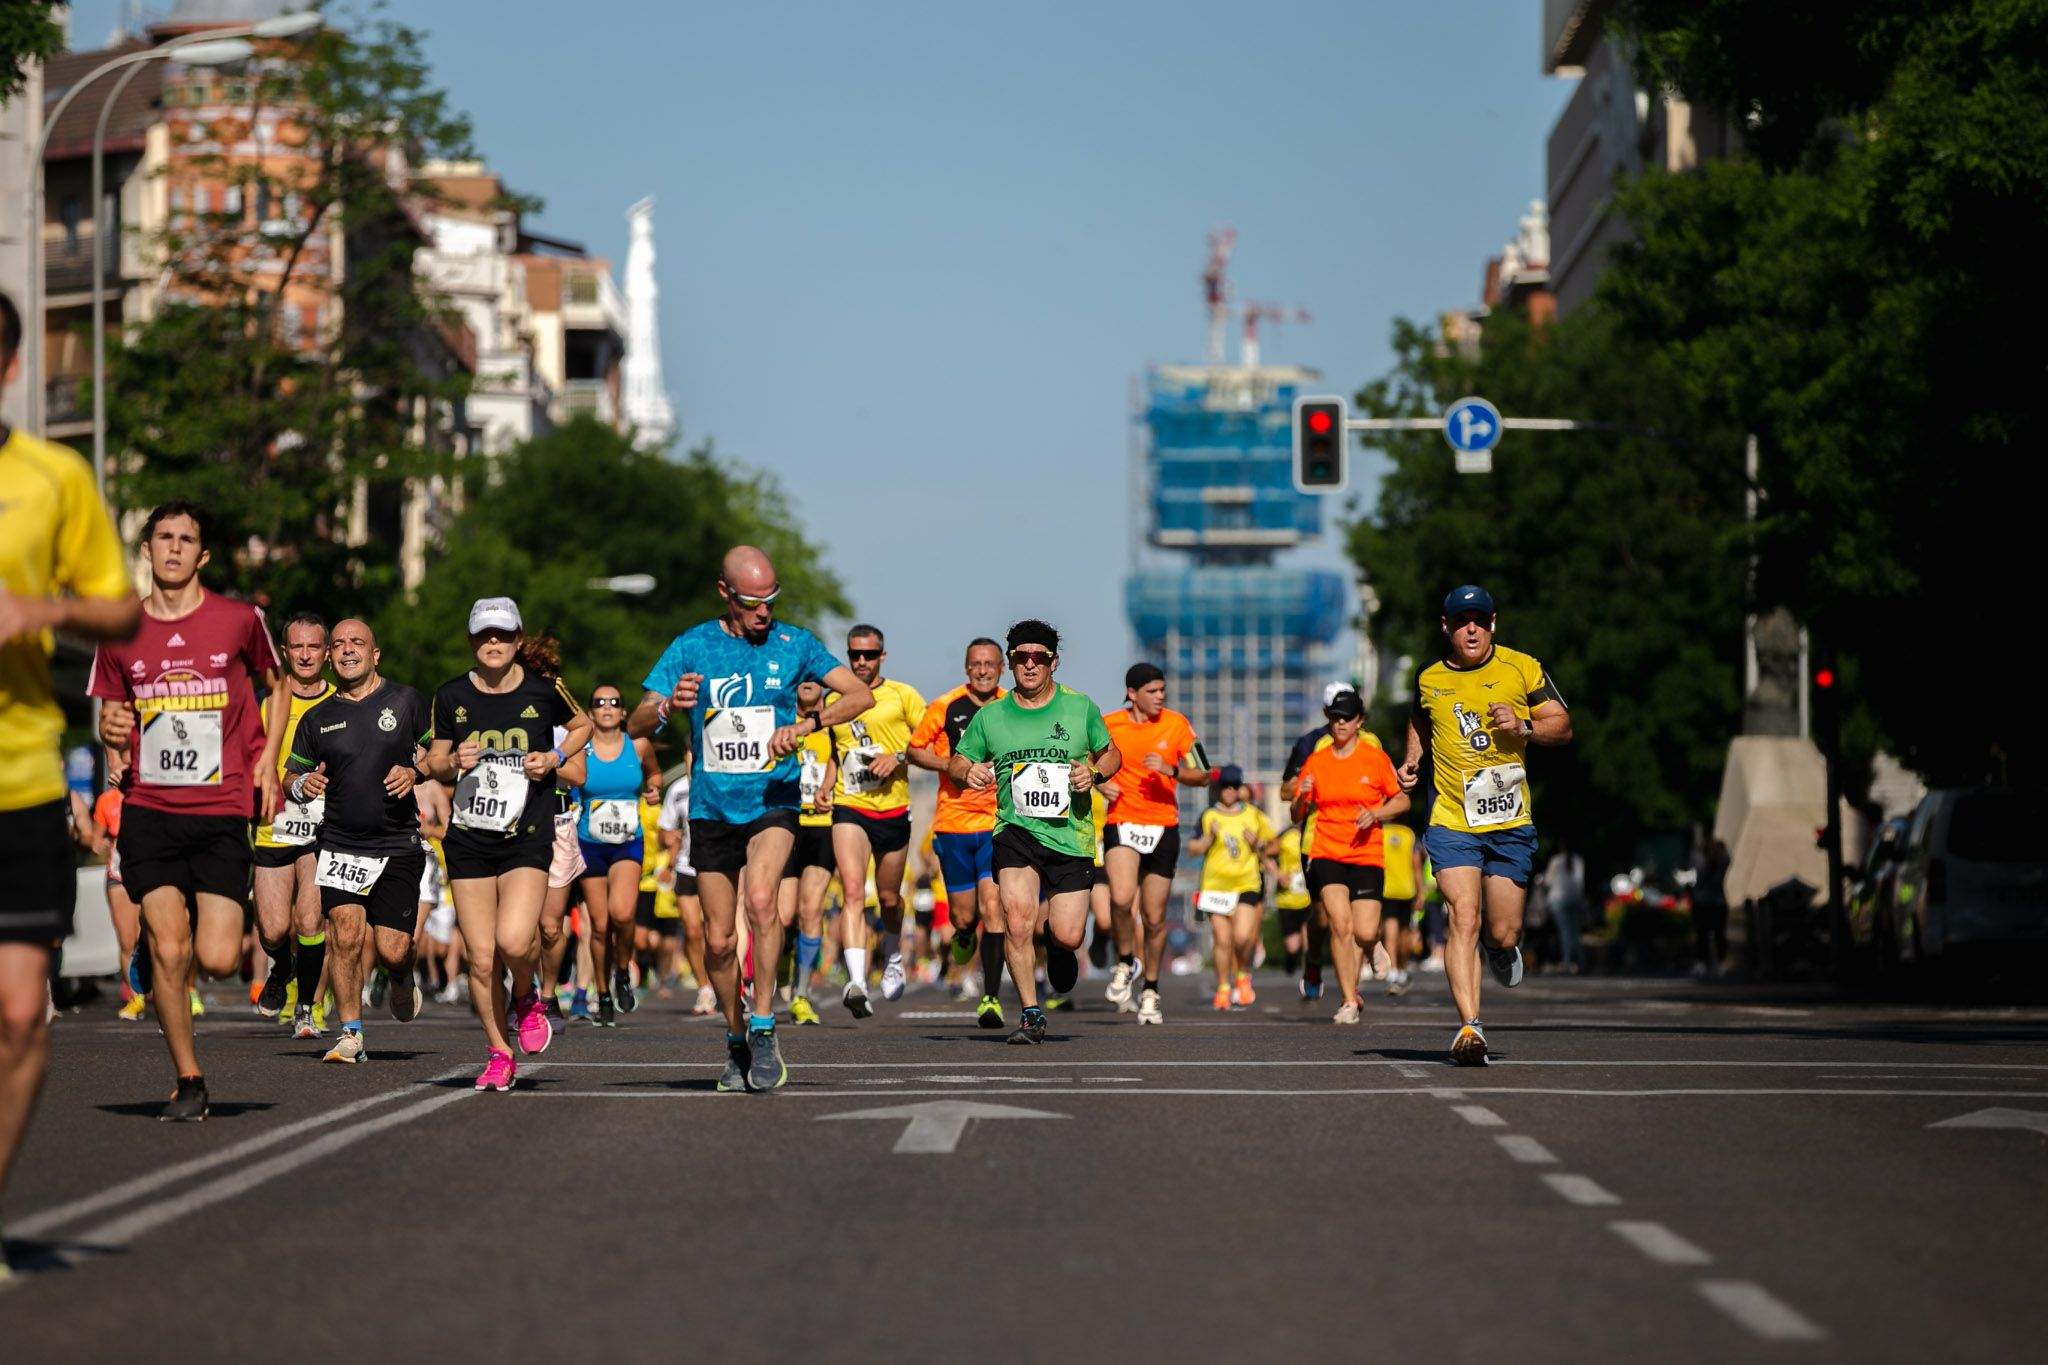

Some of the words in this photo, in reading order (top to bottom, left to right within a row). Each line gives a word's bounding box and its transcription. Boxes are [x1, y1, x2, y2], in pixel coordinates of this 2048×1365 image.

[715, 741, 760, 761] 1504
[1473, 735, 1488, 747] 13
[160, 749, 198, 771] 842
[468, 795, 508, 819] 1501
[1023, 790, 1060, 808] 1804
[1477, 792, 1515, 815] 3553
[599, 821, 628, 835] 1584
